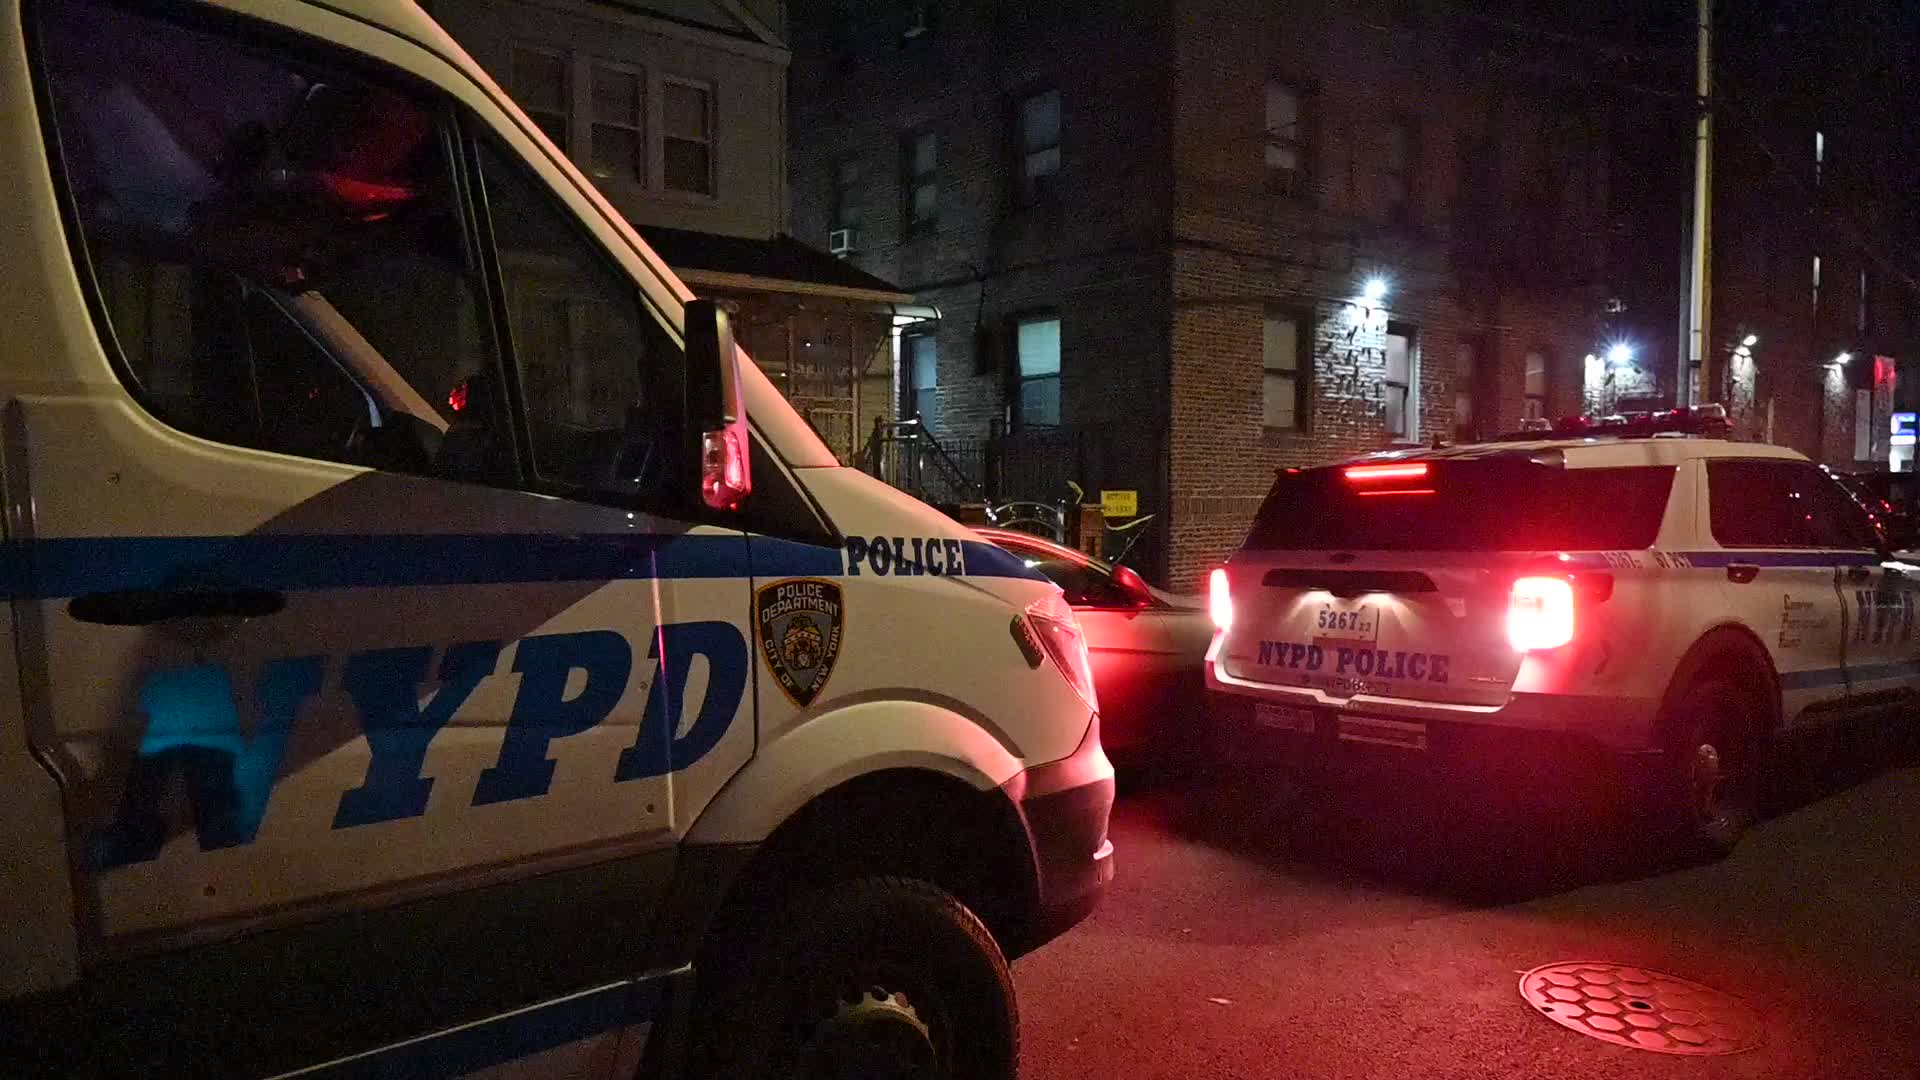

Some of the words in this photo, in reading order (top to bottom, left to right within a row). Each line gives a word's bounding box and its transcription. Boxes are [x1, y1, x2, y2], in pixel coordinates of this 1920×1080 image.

[845, 535, 964, 577] POLICE
[761, 597, 840, 624] DEPARTMENT
[777, 583, 824, 600] POLICE
[1318, 609, 1360, 631] 5267
[764, 639, 782, 669] CITY
[780, 672, 794, 688] OF
[812, 664, 829, 693] NEW
[827, 624, 842, 659] YORK
[1257, 639, 1324, 671] NYPD
[1335, 647, 1451, 683] POLICE
[94, 620, 748, 870] NYPD
